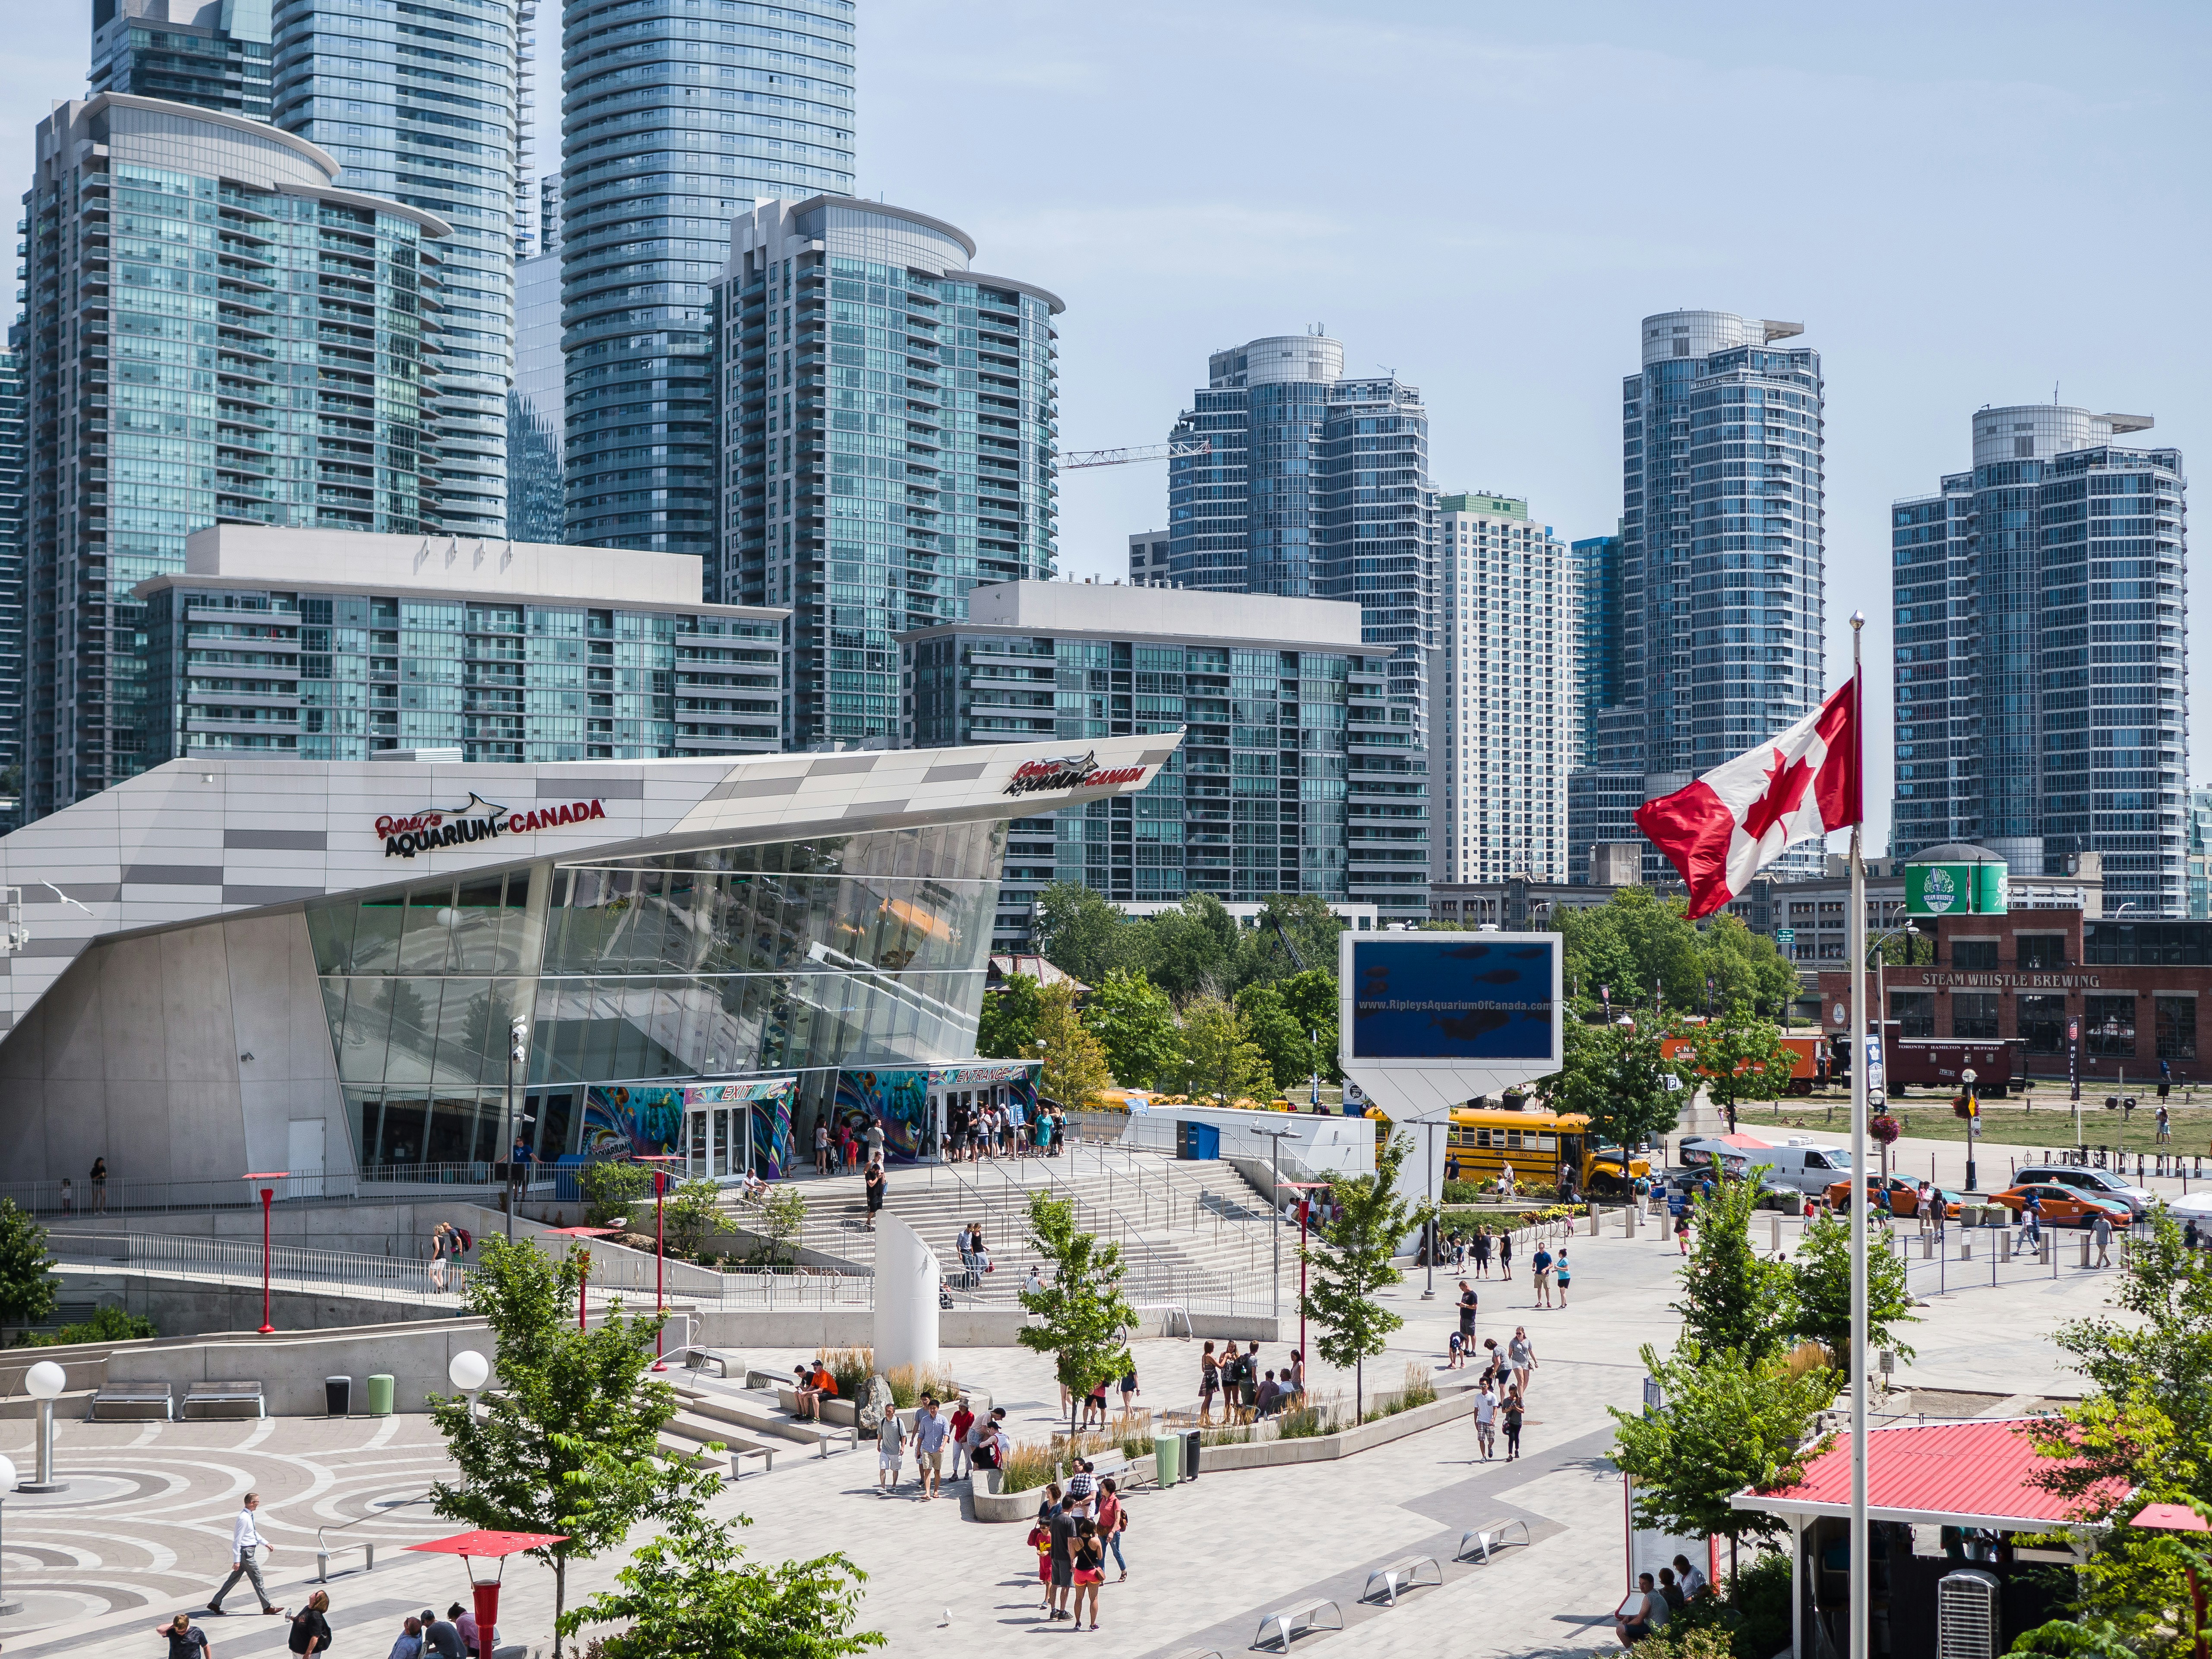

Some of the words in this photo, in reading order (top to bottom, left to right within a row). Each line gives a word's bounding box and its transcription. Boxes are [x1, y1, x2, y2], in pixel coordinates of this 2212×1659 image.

[1084, 767, 1147, 787] CANADA
[385, 817, 498, 858] AQUARIUM
[509, 799, 605, 833] CANADA
[1922, 973, 1964, 986] STEAM
[1968, 974, 2028, 986] WHISTLE
[2033, 975, 2099, 987] BREWING
[1359, 1000, 1552, 1011] www.RipleysAquariumOfCanada.com
[956, 1068, 1010, 1083] ENTRANCE
[721, 1085, 754, 1100] EXIT
